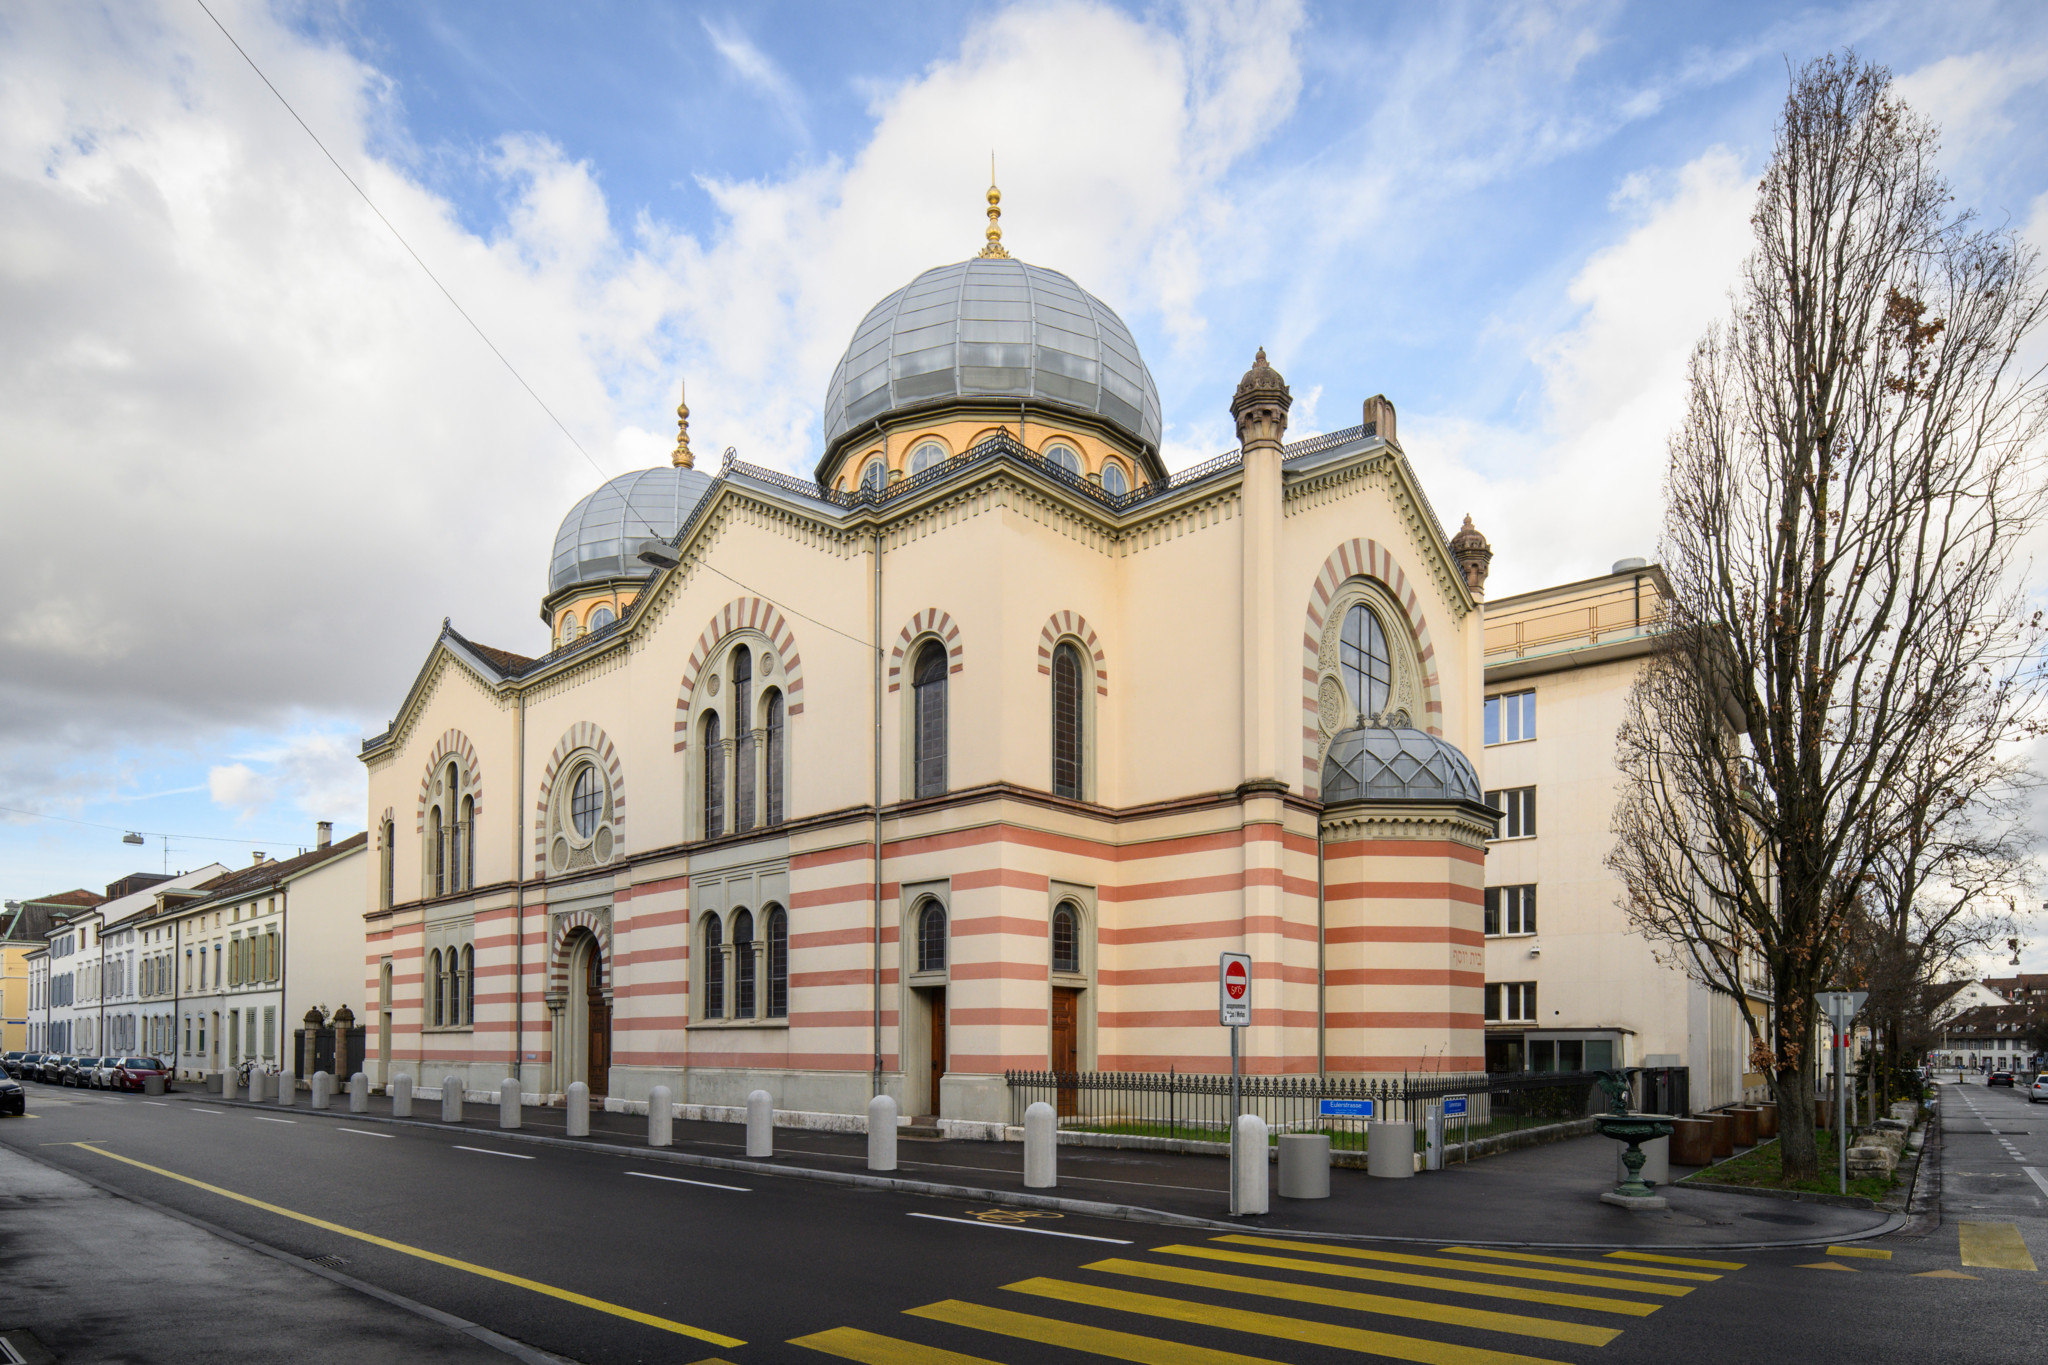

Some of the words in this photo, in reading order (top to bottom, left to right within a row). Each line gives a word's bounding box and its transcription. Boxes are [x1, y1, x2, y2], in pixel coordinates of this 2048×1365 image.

[1452, 950, 1468, 967] יוסף
[1470, 952, 1482, 966] בית
[1330, 1101, 1362, 1109] Eulerstrasse
